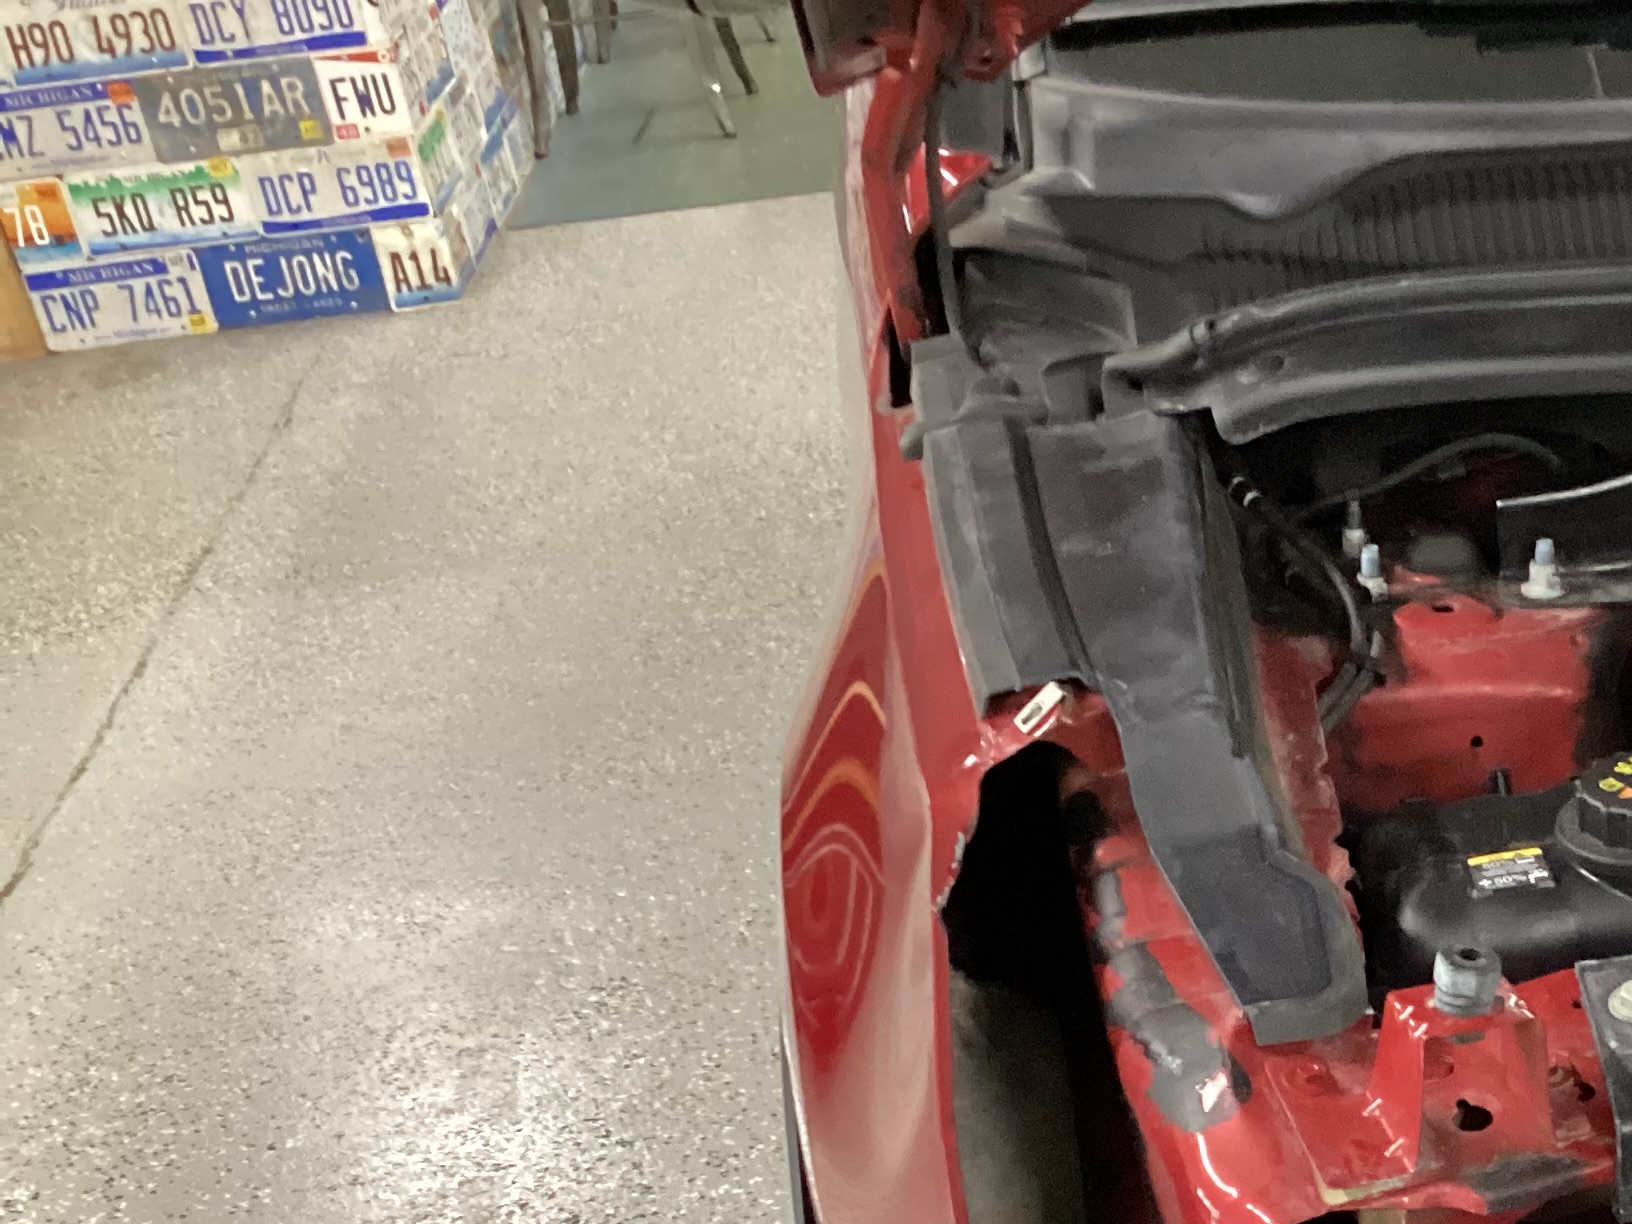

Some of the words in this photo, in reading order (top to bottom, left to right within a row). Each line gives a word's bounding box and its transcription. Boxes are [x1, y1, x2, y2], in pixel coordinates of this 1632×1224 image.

[4, 20, 75, 71] H90
[91, 7, 176, 59] 4930
[189, 0, 250, 45] DCY
[270, 0, 355, 36] 8090
[328, 72, 397, 121] FWU
[0, 115, 45, 160] MZ
[55, 103, 142, 151] 5456
[168, 182, 235, 227] R59
[257, 170, 318, 217] DCP
[335, 159, 418, 208] 6989
[389, 247, 453, 294] A14
[40, 288, 99, 333] CNP
[116, 276, 202, 322] 7461
